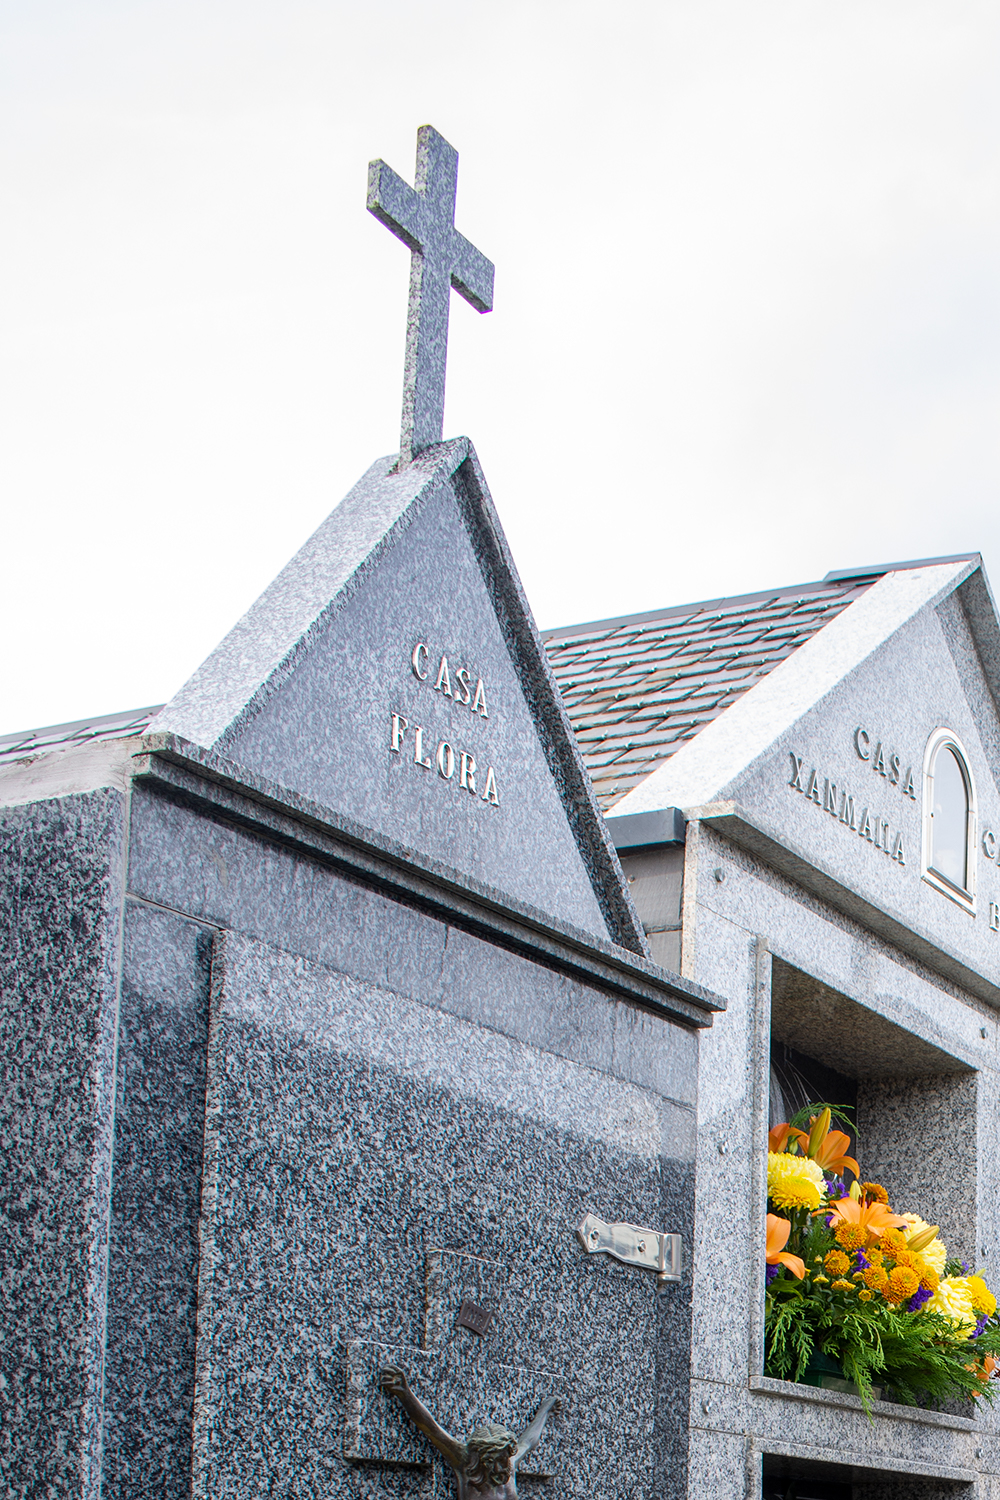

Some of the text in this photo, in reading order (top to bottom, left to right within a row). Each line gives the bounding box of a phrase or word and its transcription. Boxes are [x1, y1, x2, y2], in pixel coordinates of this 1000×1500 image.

[412, 643, 489, 719] CASA
[390, 711, 500, 807] FLORA
[854, 726, 916, 801] CASA
[788, 751, 906, 866] XANMAITA
